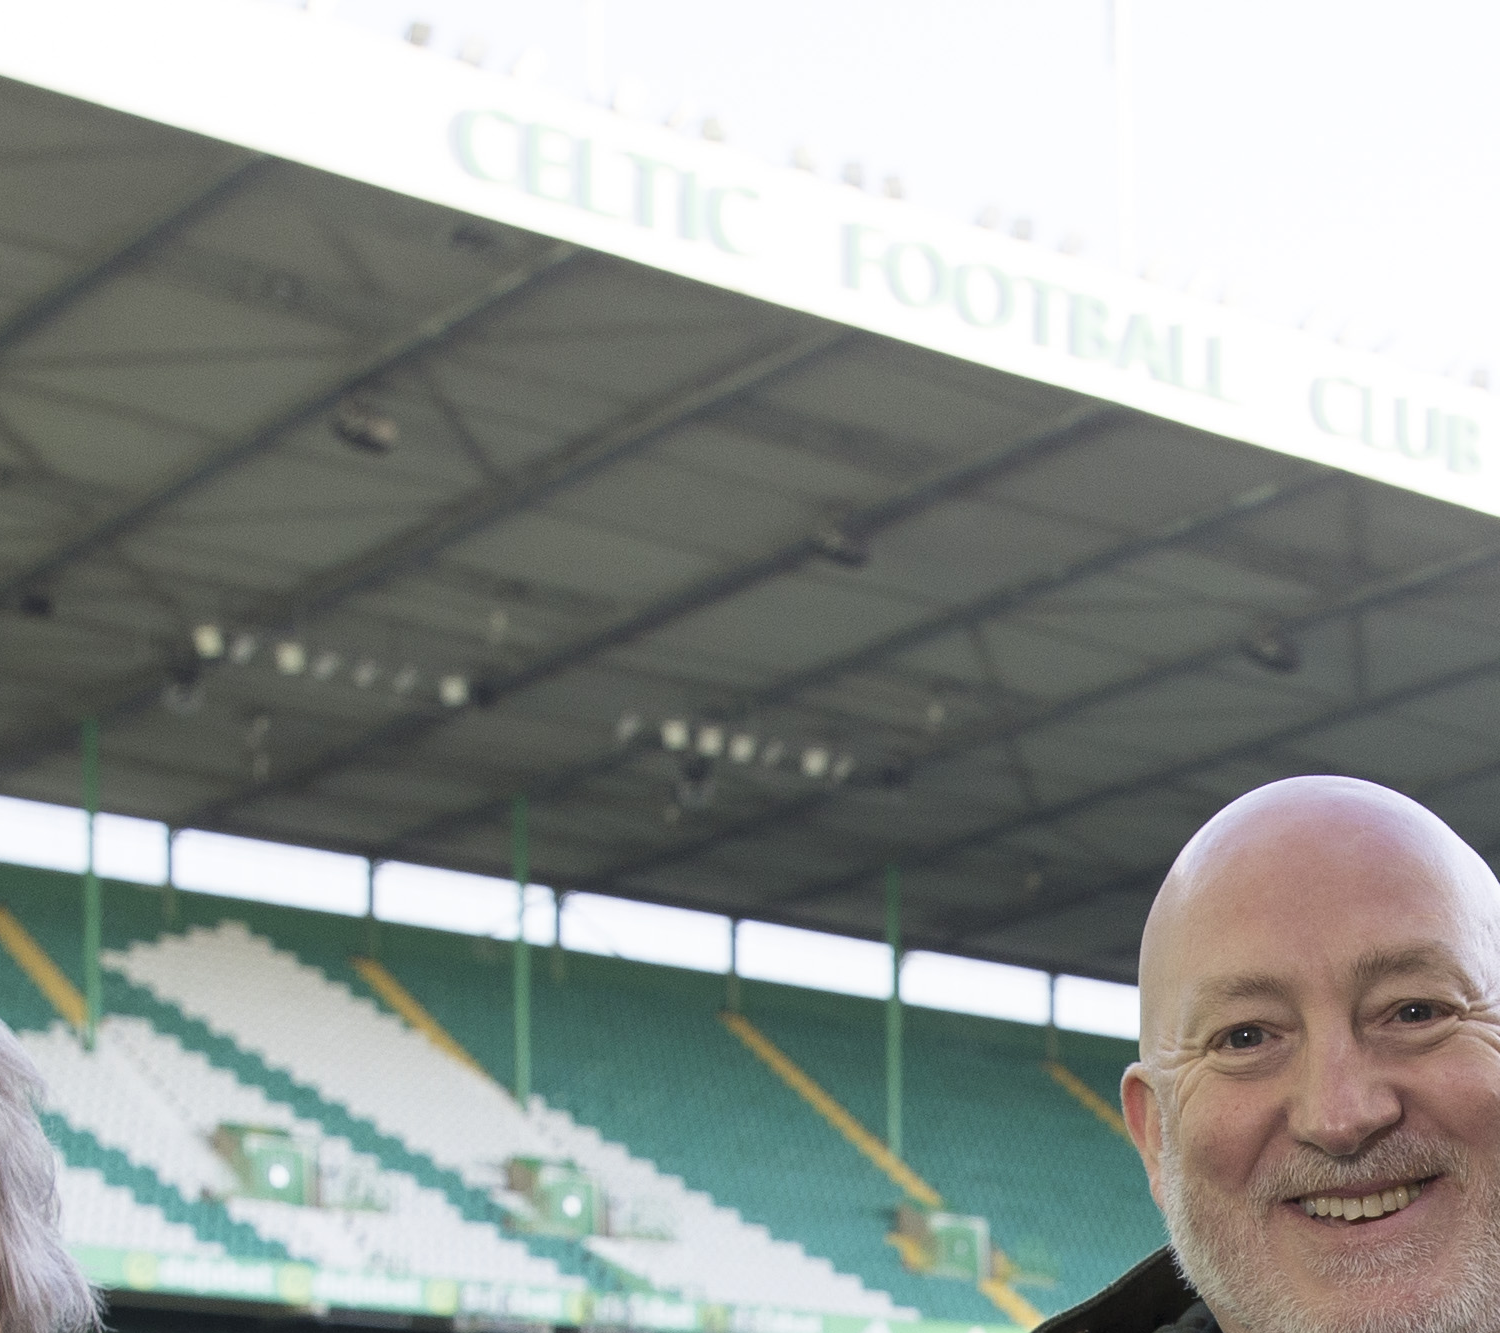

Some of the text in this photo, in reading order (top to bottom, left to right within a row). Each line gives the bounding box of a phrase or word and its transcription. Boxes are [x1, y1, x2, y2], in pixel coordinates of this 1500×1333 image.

[448, 108, 760, 256] CELTIC
[838, 221, 1238, 404] FOOTBALL
[1310, 376, 1482, 475] CLUB
